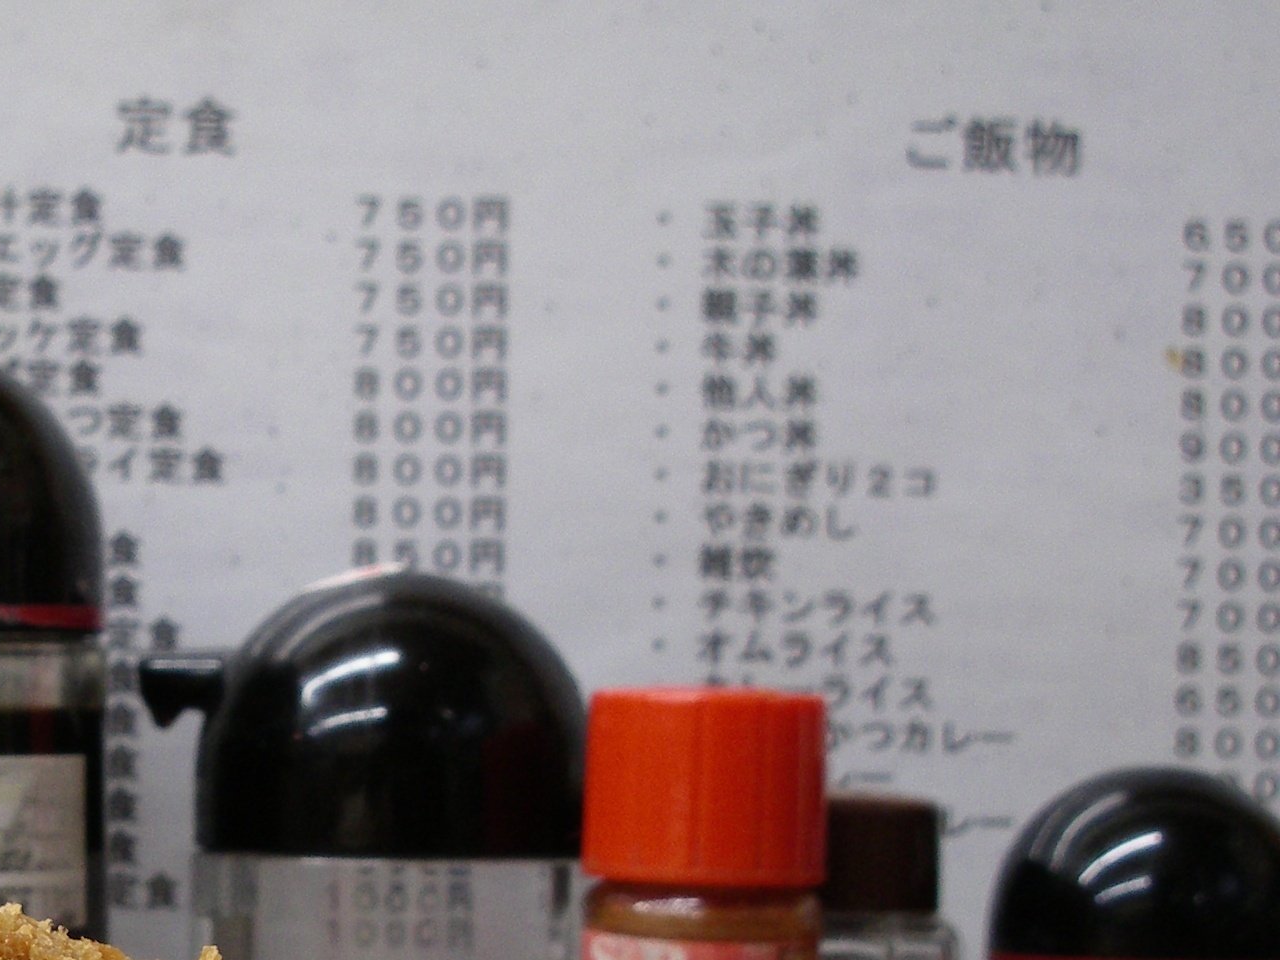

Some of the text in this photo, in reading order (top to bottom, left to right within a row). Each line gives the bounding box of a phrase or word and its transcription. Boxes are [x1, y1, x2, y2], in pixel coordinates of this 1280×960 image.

[118, 97, 233, 155] 定食
[908, 117, 1082, 176] ご飯物
[704, 419, 816, 451] かつ丼
[705, 503, 852, 542] やきめし
[701, 587, 934, 625] チキンライス
[699, 630, 892, 669] オムライス
